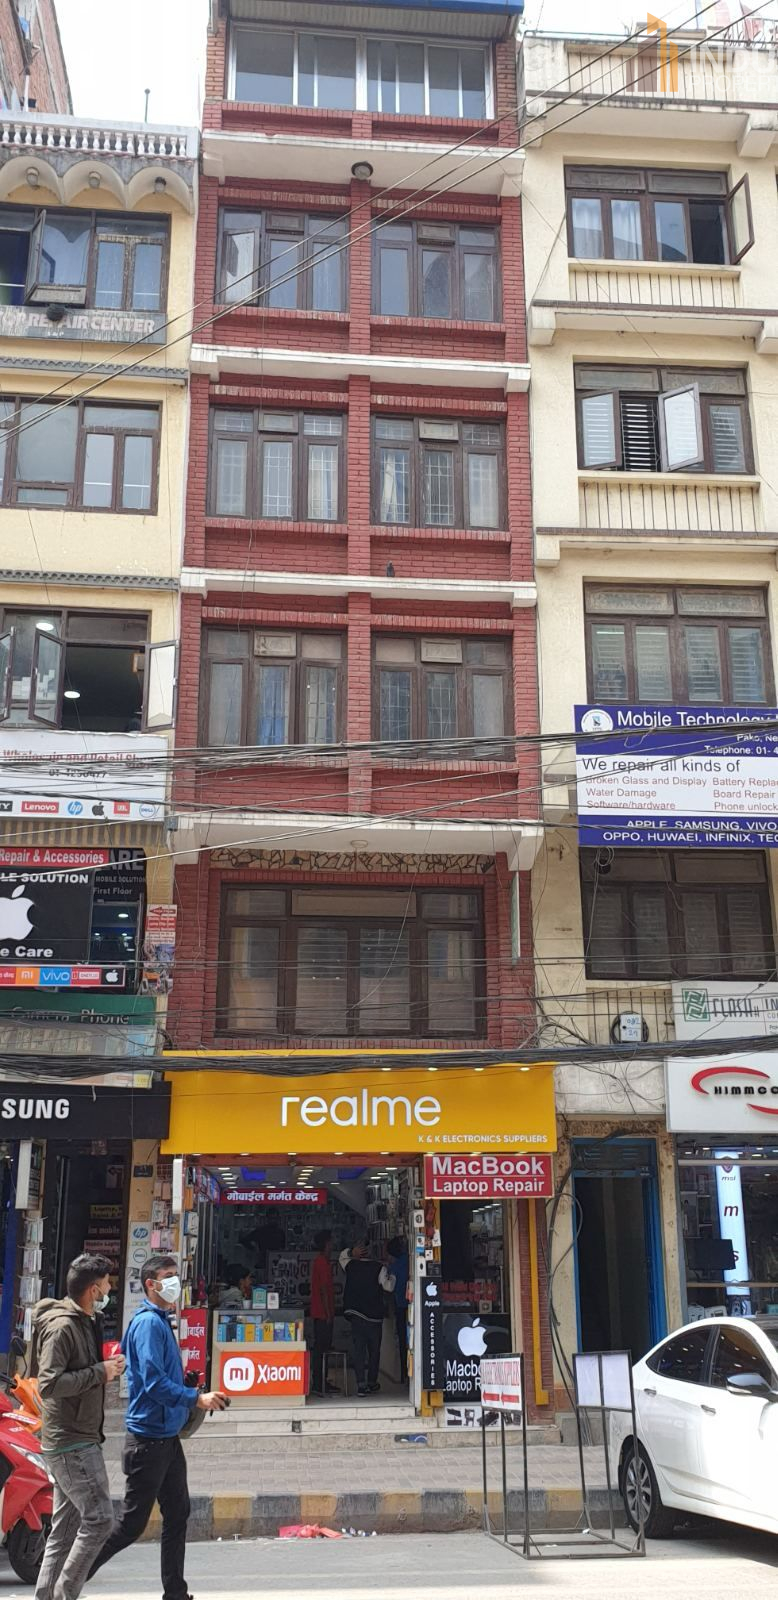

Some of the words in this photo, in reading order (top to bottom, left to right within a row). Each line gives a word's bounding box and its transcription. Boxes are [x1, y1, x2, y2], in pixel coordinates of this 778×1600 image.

[29, 312, 89, 329] REAIR
[90, 317, 156, 332] CENTER
[617, 711, 672, 727] Mobile
[582, 758, 607, 771] We
[613, 759, 653, 773] repair
[660, 760, 677, 771] all
[682, 759, 721, 772] kinds
[727, 759, 740, 772] of
[622, 776, 649, 785] Glass
[652, 777, 669, 785] and
[673, 777, 707, 787] Display
[713, 777, 745, 788] Battery
[586, 788, 615, 797] Water
[617, 788, 657, 798] Damage
[713, 789, 741, 798] Board
[744, 790, 776, 800] Repair
[714, 802, 745, 811] Phone
[603, 832, 644, 843] OPPO,
[647, 832, 702, 843] HUWAEI,
[705, 833, 755, 844] INFINIX,
[33, 850, 40, 861] &
[43, 850, 104, 864] Accessories
[20, 873, 89, 884] SOLUTION
[15, 946, 54, 958] Care
[42, 969, 70, 981] vivo
[1, 1098, 70, 1119] SUNG
[281, 1088, 442, 1127] realme
[427, 1135, 433, 1143] &
[435, 1135, 441, 1143] K
[443, 1135, 501, 1143] ELECTRONICS
[503, 1135, 548, 1143] SUPPLIERS
[432, 1156, 545, 1175] MacBook
[433, 1178, 489, 1195] Laptop
[493, 1178, 545, 1195] Repair
[256, 1363, 301, 1383] Xiaomi
[443, 1378, 473, 1395] aptop
